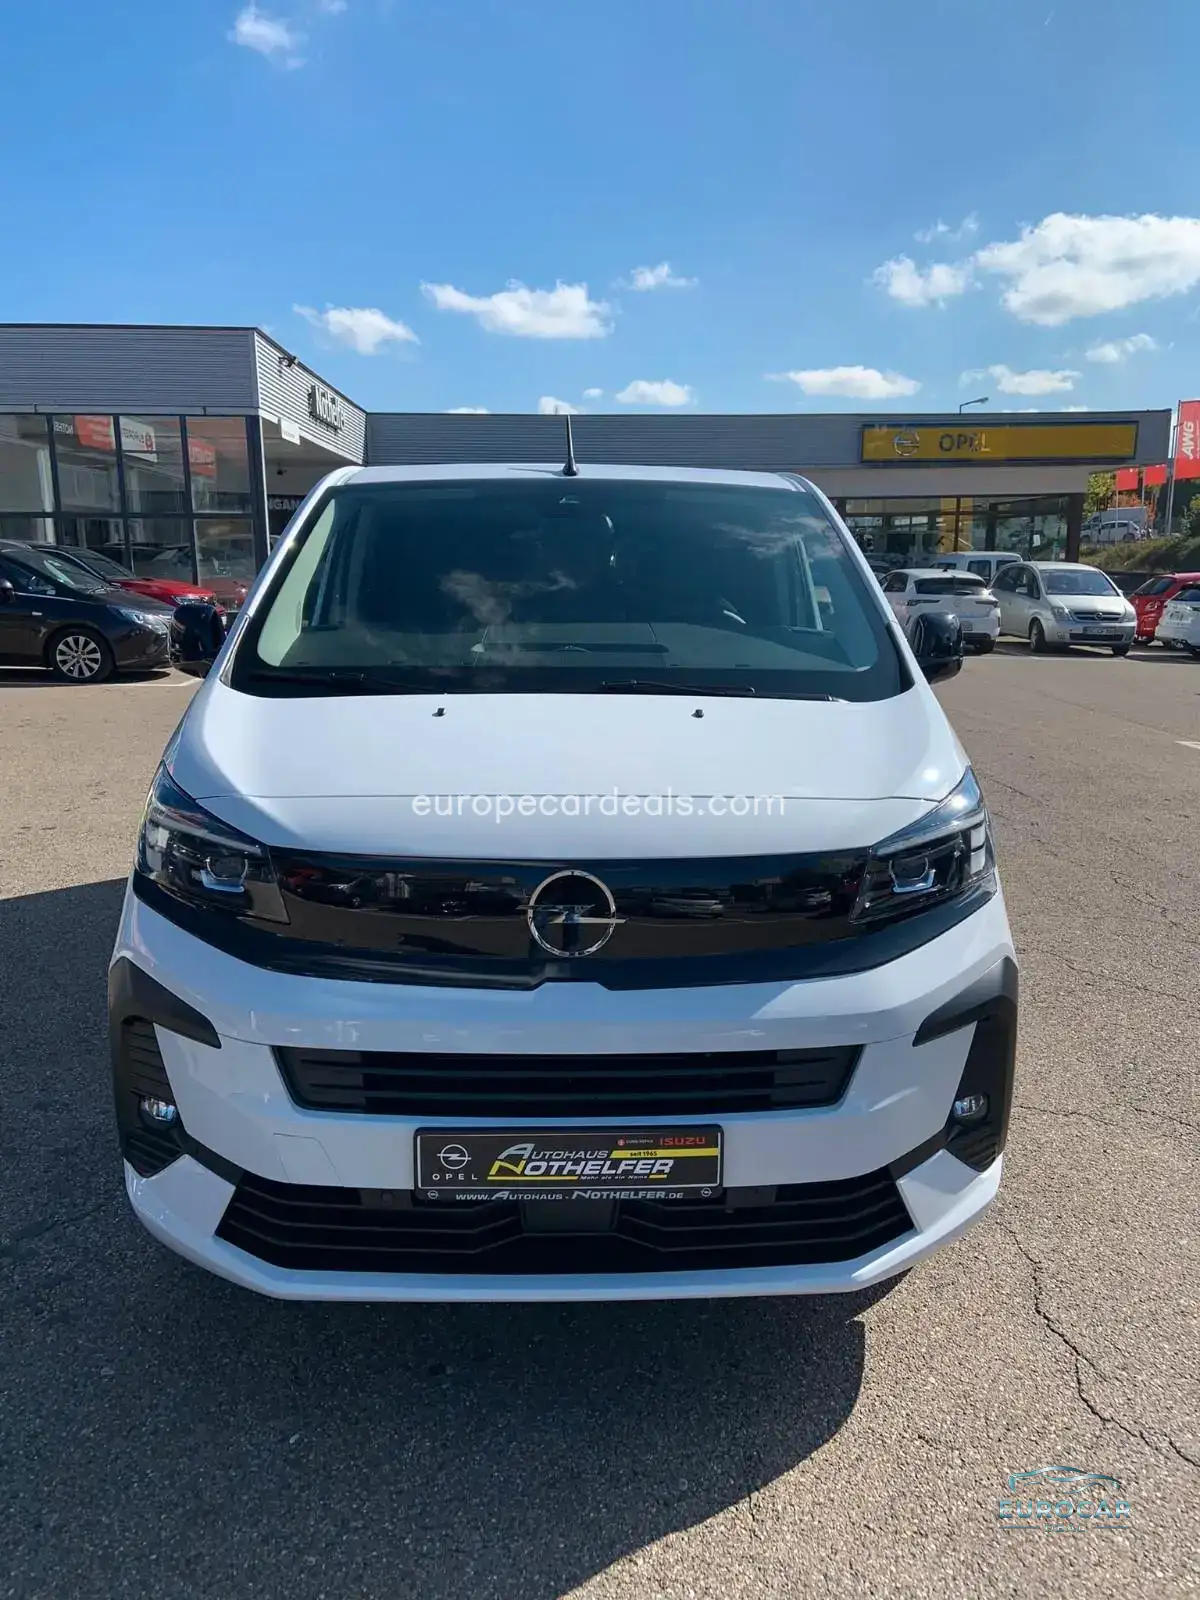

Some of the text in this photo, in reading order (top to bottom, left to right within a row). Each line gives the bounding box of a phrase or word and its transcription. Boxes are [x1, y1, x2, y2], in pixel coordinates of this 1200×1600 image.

[1182, 421, 1195, 460] AWG
[660, 1136, 706, 1146] ISUZU
[432, 1173, 479, 1181] OPEL
